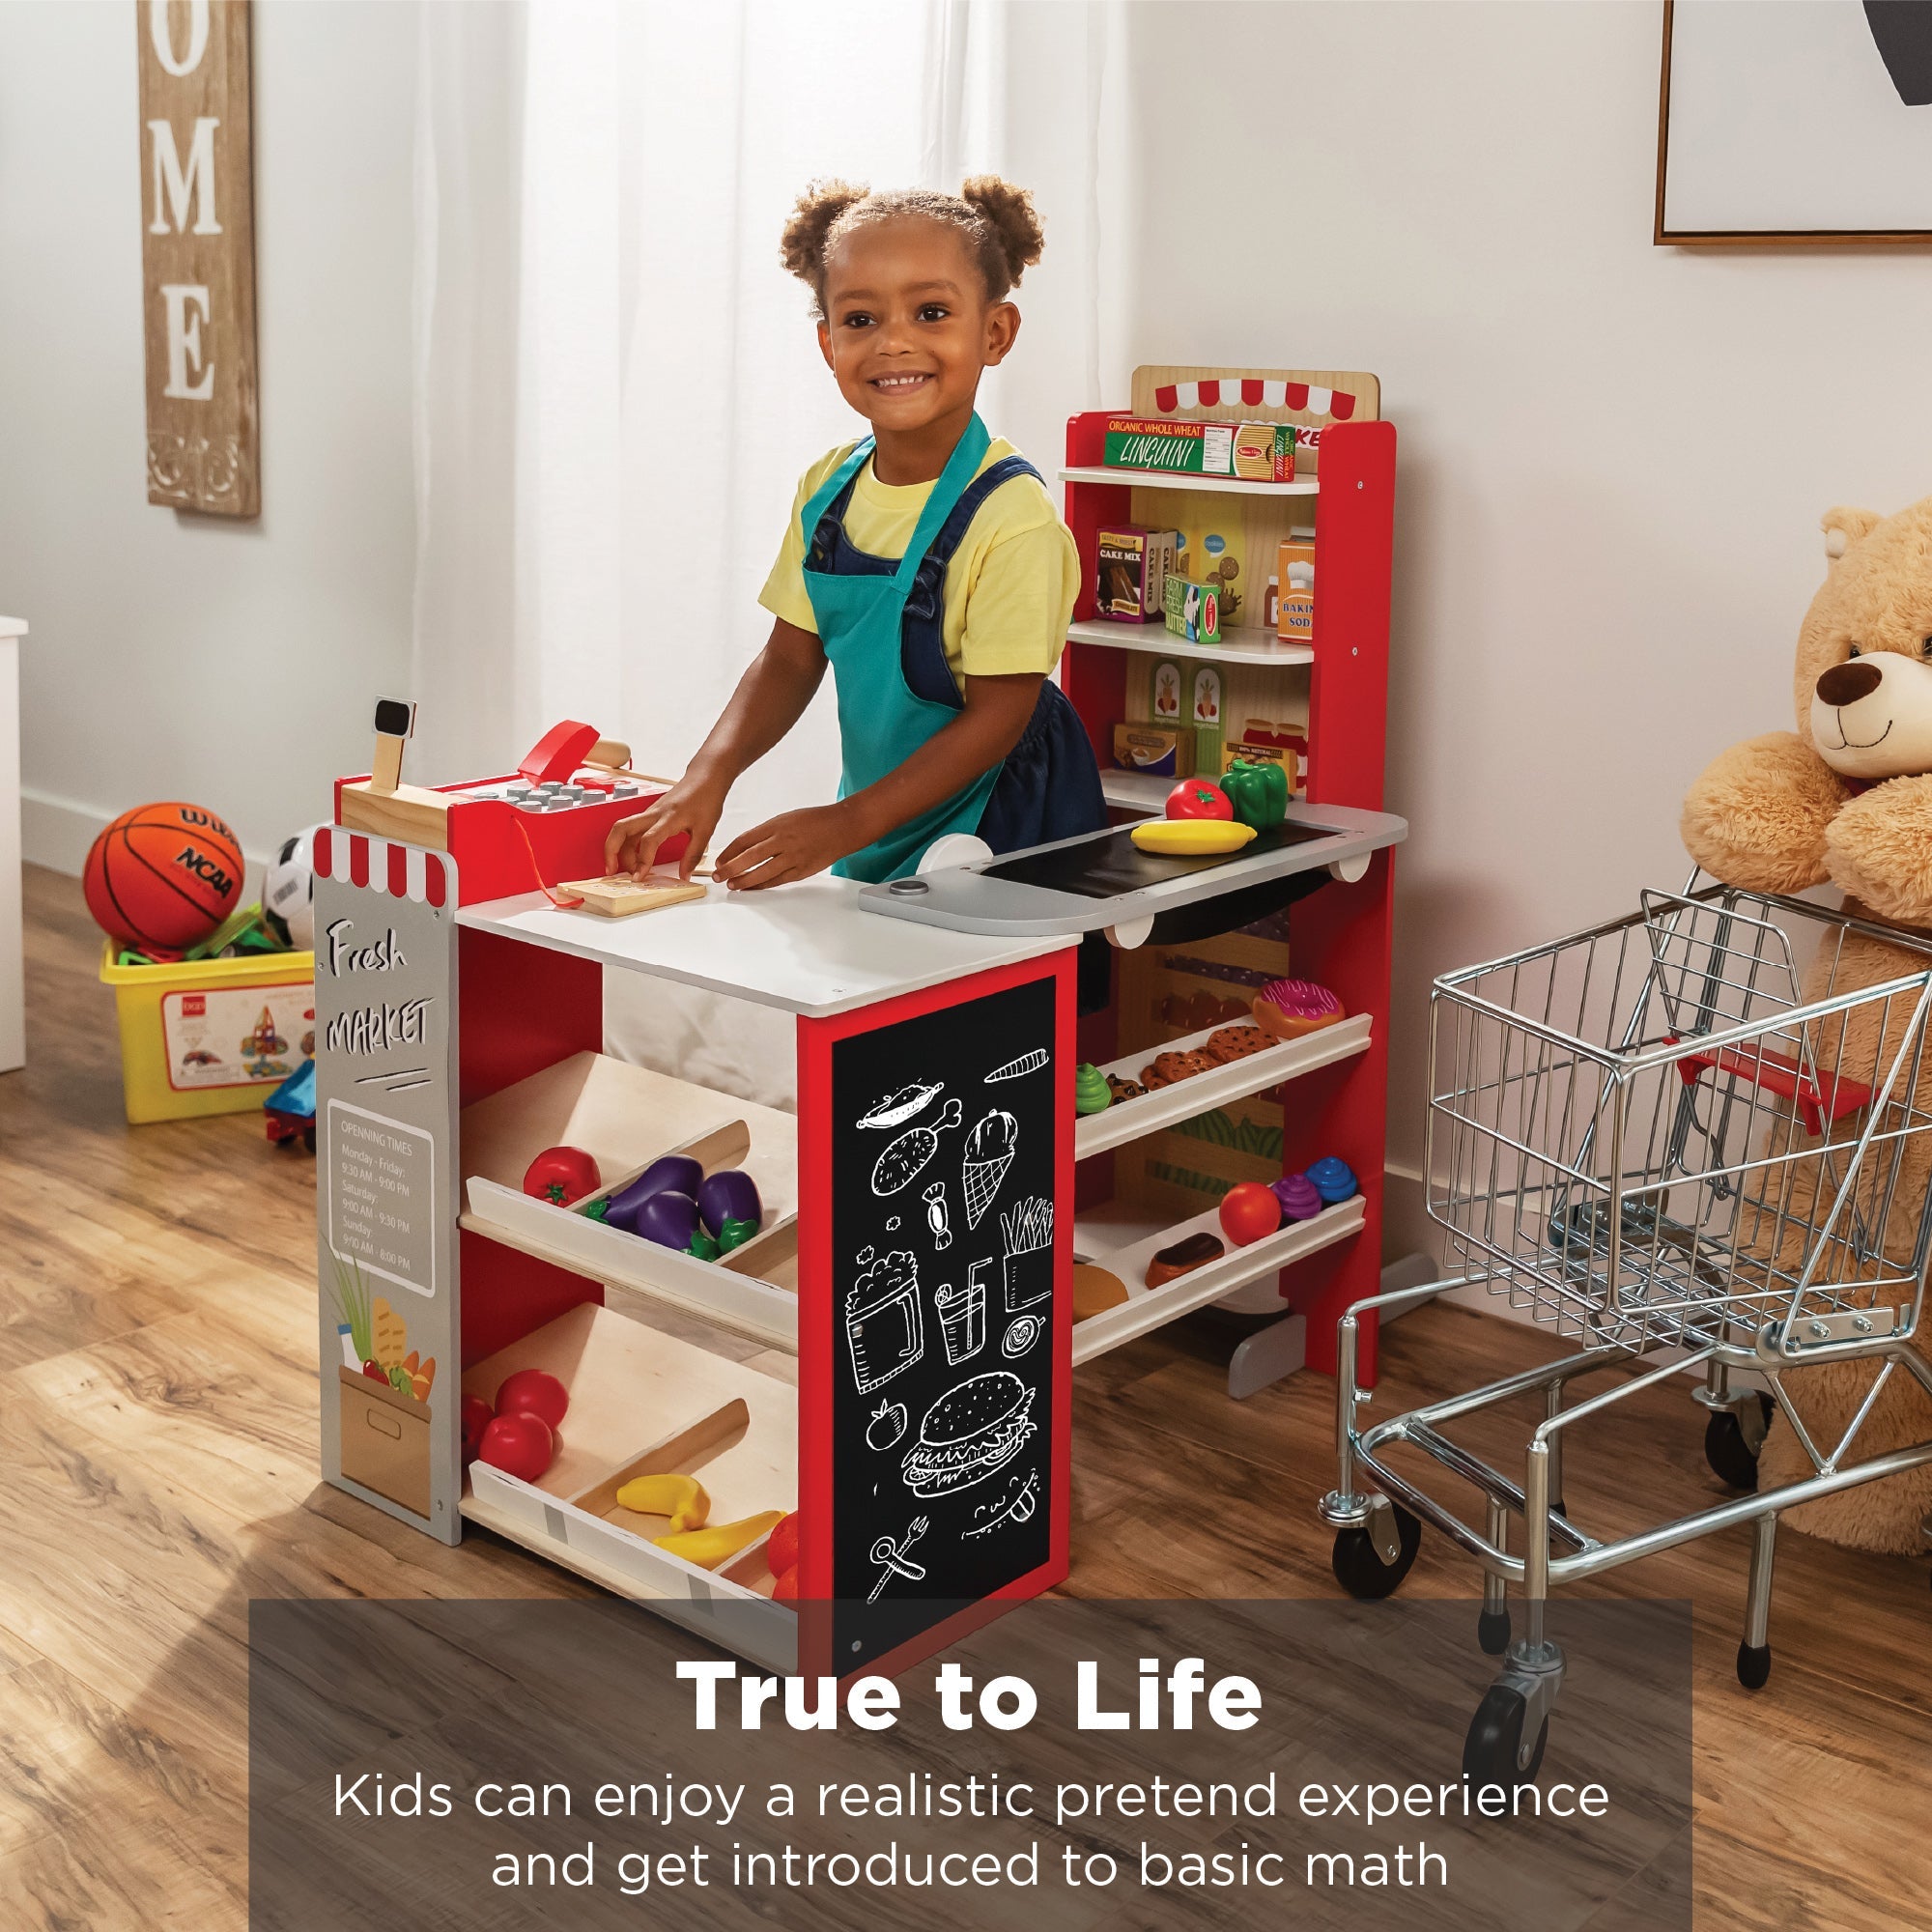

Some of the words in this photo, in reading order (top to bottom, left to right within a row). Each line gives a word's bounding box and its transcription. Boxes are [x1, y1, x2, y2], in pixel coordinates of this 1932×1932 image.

[1108, 420, 1143, 434] ORGANIC
[1144, 423, 1173, 435] WHOLE
[1174, 426, 1201, 437] WHEAT
[1120, 436, 1195, 469] LINGUINI
[1275, 434, 1284, 477] LINGUINI
[1099, 549, 1122, 559] CAKE
[1124, 552, 1141, 561] MIX
[1290, 617, 1312, 627] SOD
[176, 847, 233, 899] NCAA
[326, 918, 409, 978] Fresh
[327, 996, 437, 1057] MARKET
[341, 1120, 385, 1147] OPENNING
[386, 1135, 412, 1156] TIMES
[342, 1143, 373, 1167] Monday
[341, 1162, 358, 1178] 9:30
[359, 1168, 373, 1182] AM
[379, 1176, 396, 1192] 9:00
[397, 1181, 410, 1197] PM
[342, 1197, 359, 1213] 9:00
[359, 1205, 373, 1218] AM
[379, 1212, 396, 1229] 9:30
[397, 1219, 411, 1234] PM
[360, 1240, 374, 1256] AM
[380, 1248, 396, 1264] 8:00
[397, 1256, 411, 1271] PM
